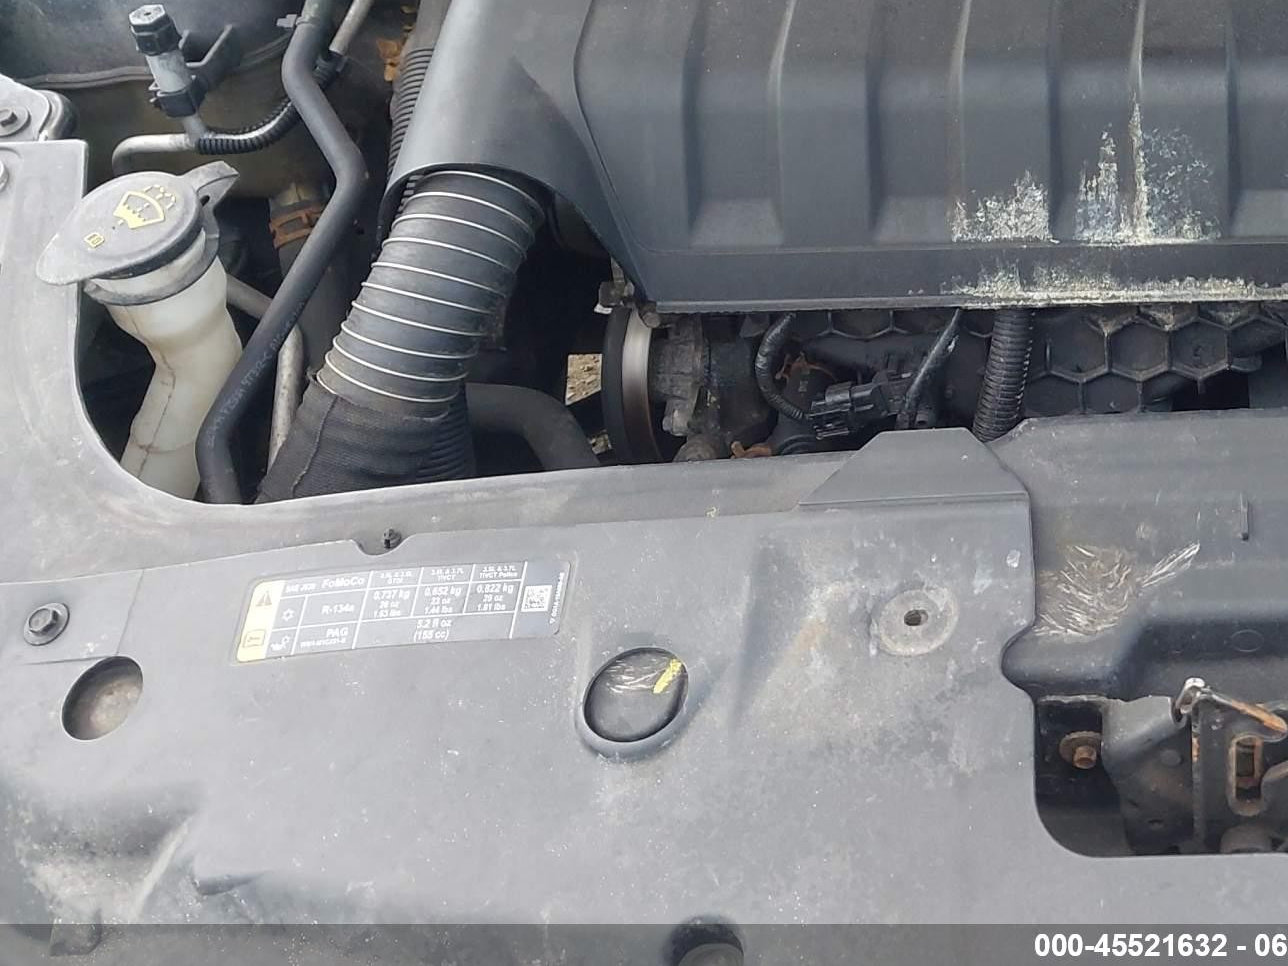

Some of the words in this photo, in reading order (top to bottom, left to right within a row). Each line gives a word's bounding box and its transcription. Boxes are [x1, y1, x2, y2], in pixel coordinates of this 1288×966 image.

[321, 576, 367, 589] FoMoCo
[450, 585, 463, 596] kg
[476, 584, 501, 594] 0.822
[502, 583, 515, 594] kg
[373, 590, 398, 601] 0.737
[399, 588, 411, 601] kg
[494, 594, 504, 602] oz
[390, 600, 401, 608] oz
[441, 596, 451, 605] oz
[321, 603, 355, 615] R-134a
[441, 604, 453, 613] lbs
[493, 602, 506, 611] lbs
[389, 608, 401, 617] lbs
[416, 619, 432, 629] 5.2
[440, 618, 452, 628] oz
[326, 626, 349, 638] PAG
[413, 630, 434, 643] (155
[435, 628, 450, 641] cc)
